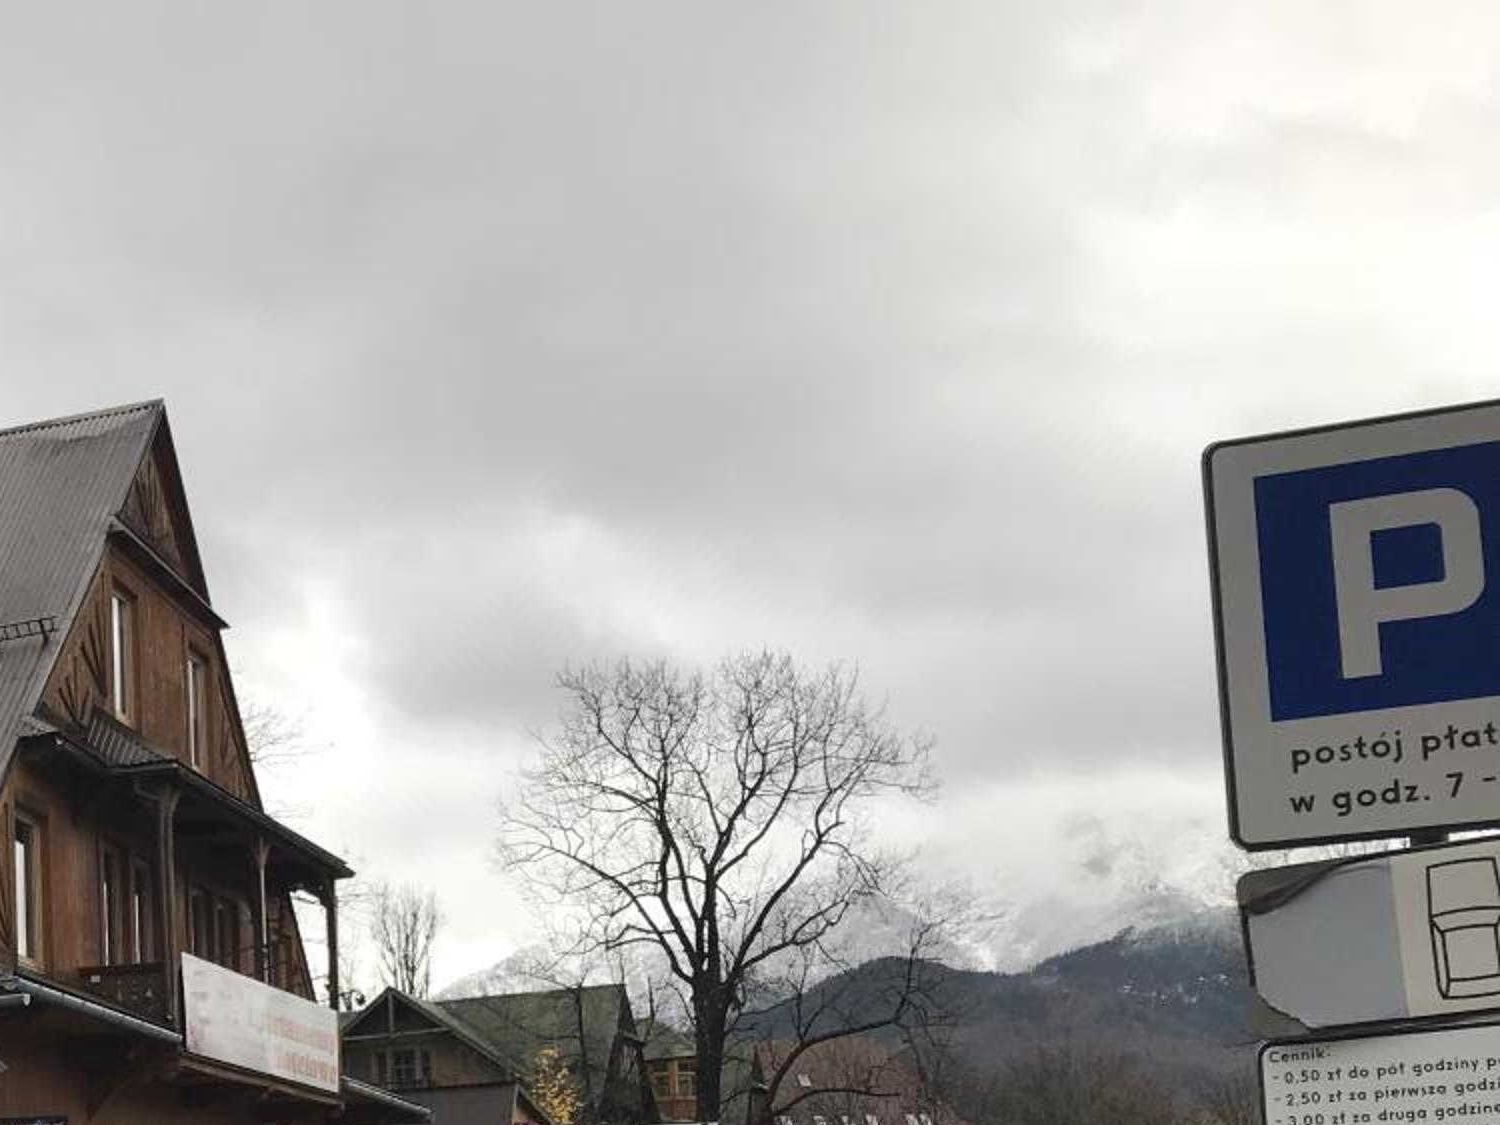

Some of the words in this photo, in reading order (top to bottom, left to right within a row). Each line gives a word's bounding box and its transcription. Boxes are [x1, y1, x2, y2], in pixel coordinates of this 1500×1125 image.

[1329, 487, 1485, 680] P
[1291, 730, 1403, 774] postój
[1421, 721, 1498, 761] płat
[1289, 796, 1315, 813] w
[1332, 778, 1431, 817] godz.
[1446, 772, 1463, 798] 7
[1349, 1066, 1369, 1079] do
[1412, 1058, 1479, 1077] godziny
[1349, 1091, 1367, 1101] za
[1353, 1113, 1371, 1123] za
